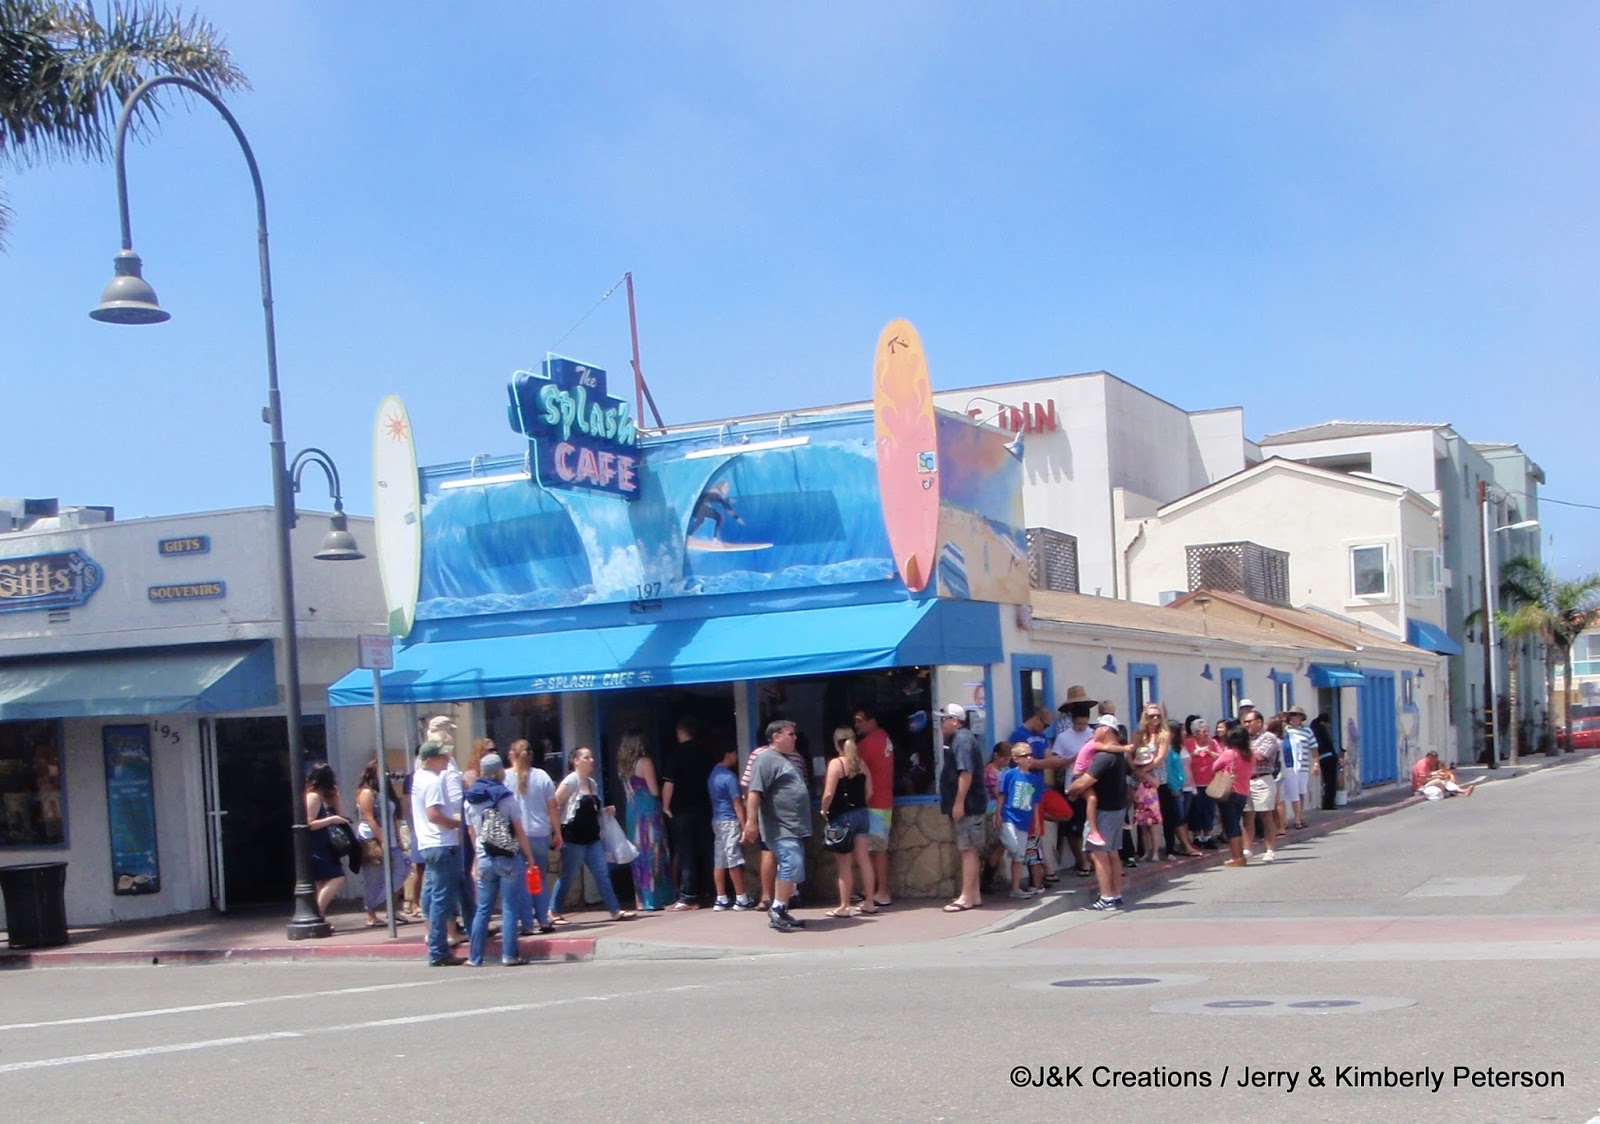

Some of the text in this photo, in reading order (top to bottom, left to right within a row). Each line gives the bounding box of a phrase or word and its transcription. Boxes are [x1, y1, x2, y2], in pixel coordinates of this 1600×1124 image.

[575, 365, 597, 388] The
[998, 399, 1056, 434] INN
[554, 442, 637, 492] CAFE
[164, 538, 201, 552] GIFTS
[150, 583, 221, 599] SOUVENIRS
[636, 582, 662, 600] 197
[547, 671, 635, 690] SPLASH CAFE
[154, 720, 180, 744] 195
